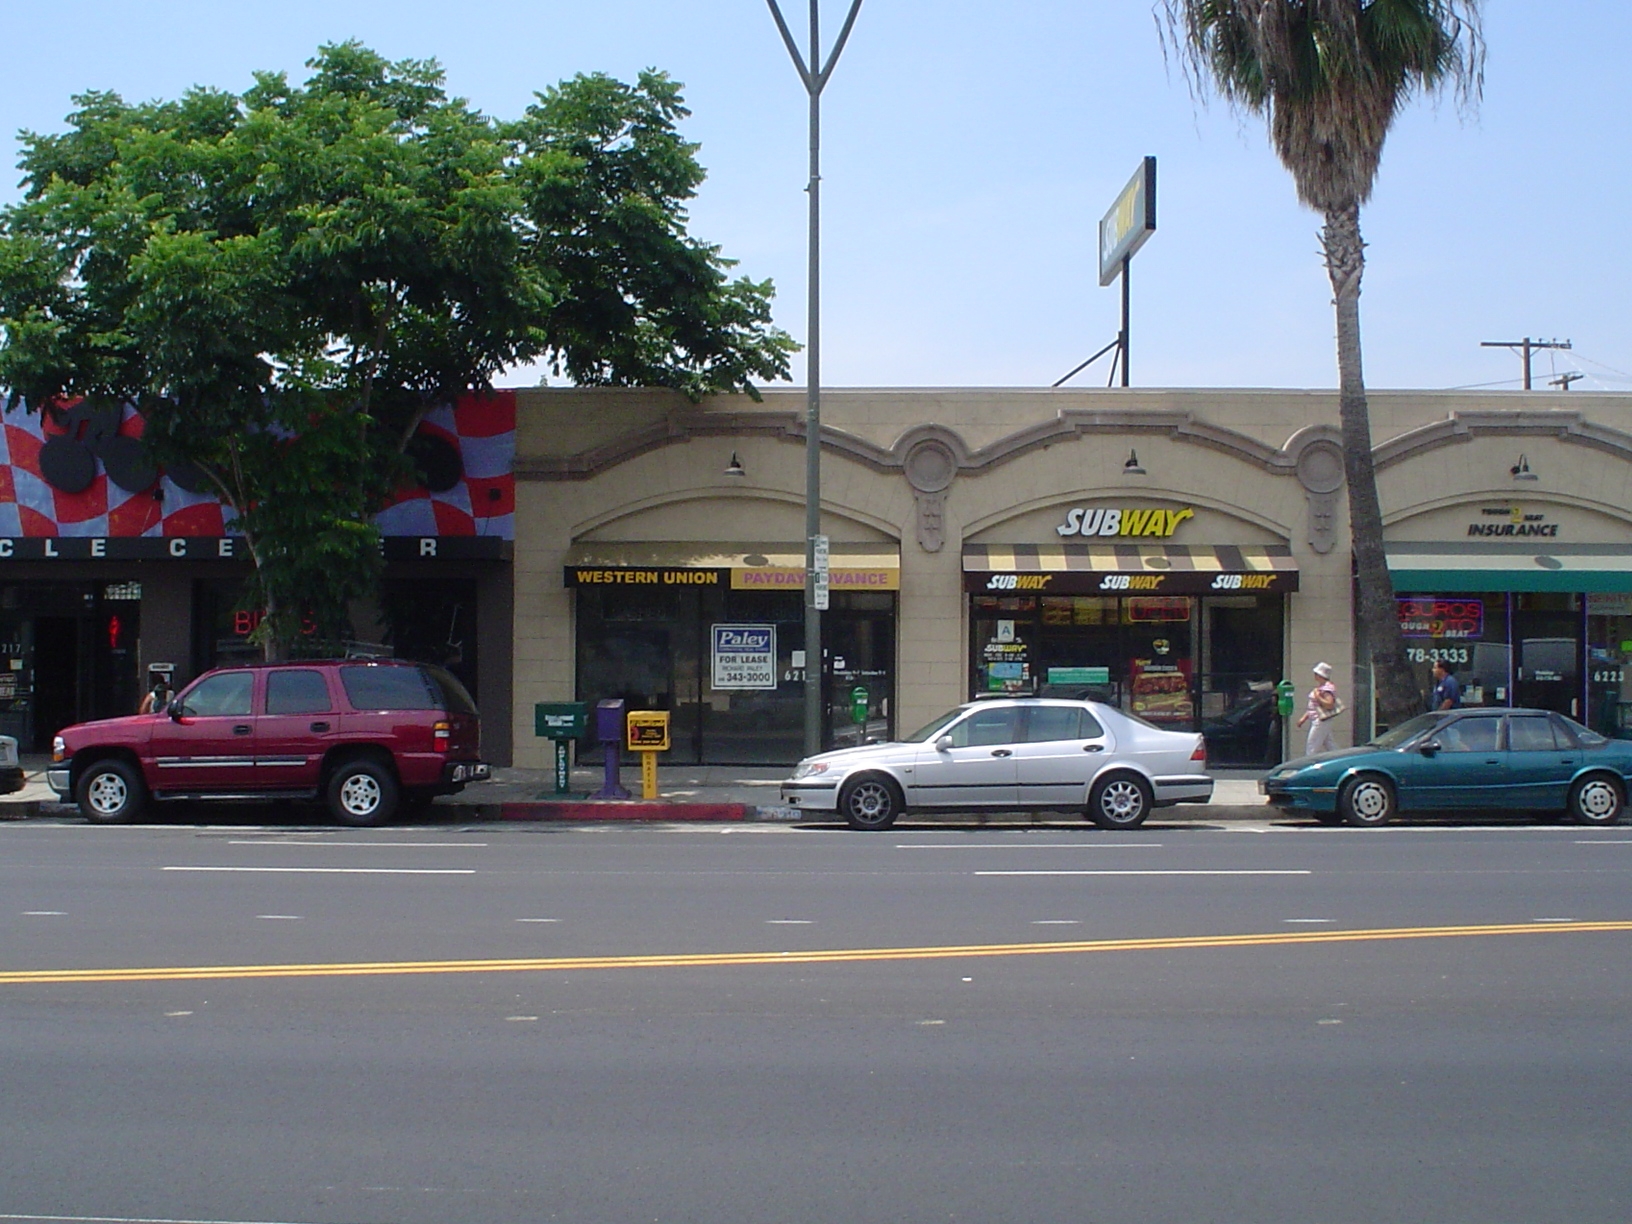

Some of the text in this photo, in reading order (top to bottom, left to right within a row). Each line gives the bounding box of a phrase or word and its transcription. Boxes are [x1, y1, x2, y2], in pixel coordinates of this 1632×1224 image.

[1057, 507, 1194, 537] SUBWAY
[1510, 506, 1522, 523] 2
[1467, 523, 1558, 537] INSURANCE
[577, 570, 718, 584] WESTERN UNION
[743, 572, 805, 585] PAYDAY
[986, 574, 1052, 590] SUBWAY
[1099, 574, 1165, 590] SUBWAY
[1211, 574, 1277, 589] SUBWAY
[1001, 625, 1011, 635] A
[1400, 622, 1429, 630] OUGH
[1430, 620, 1444, 638] 2
[718, 631, 768, 647] Paley
[984, 644, 1027, 652] SUBWAY
[1406, 648, 1469, 663] 78-3333
[726, 673, 770, 682] 343-3000
[1594, 670, 1625, 681] 6223
